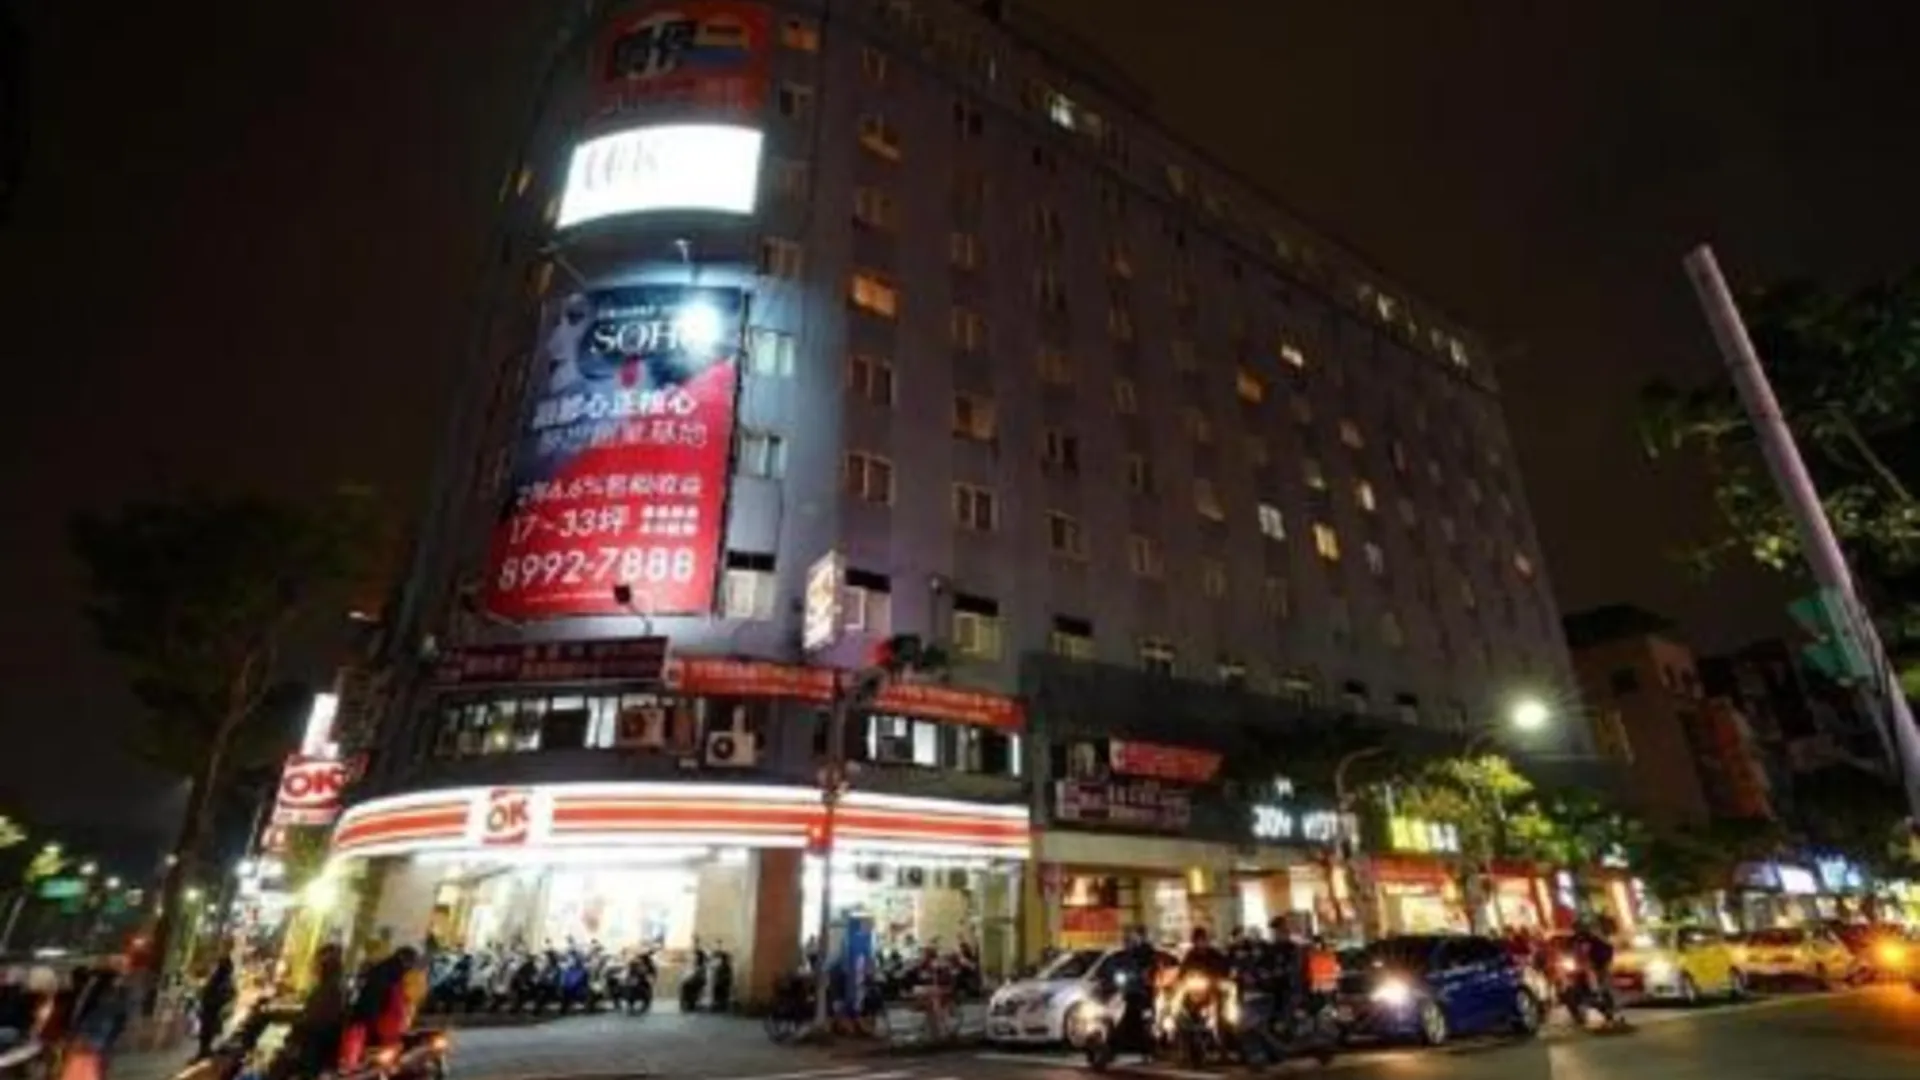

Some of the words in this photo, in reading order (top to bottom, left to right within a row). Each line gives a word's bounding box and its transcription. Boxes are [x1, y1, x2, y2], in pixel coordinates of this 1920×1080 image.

[498, 547, 696, 591] 8992-7888
[283, 769, 347, 797] OK
[486, 798, 528, 832] OK
